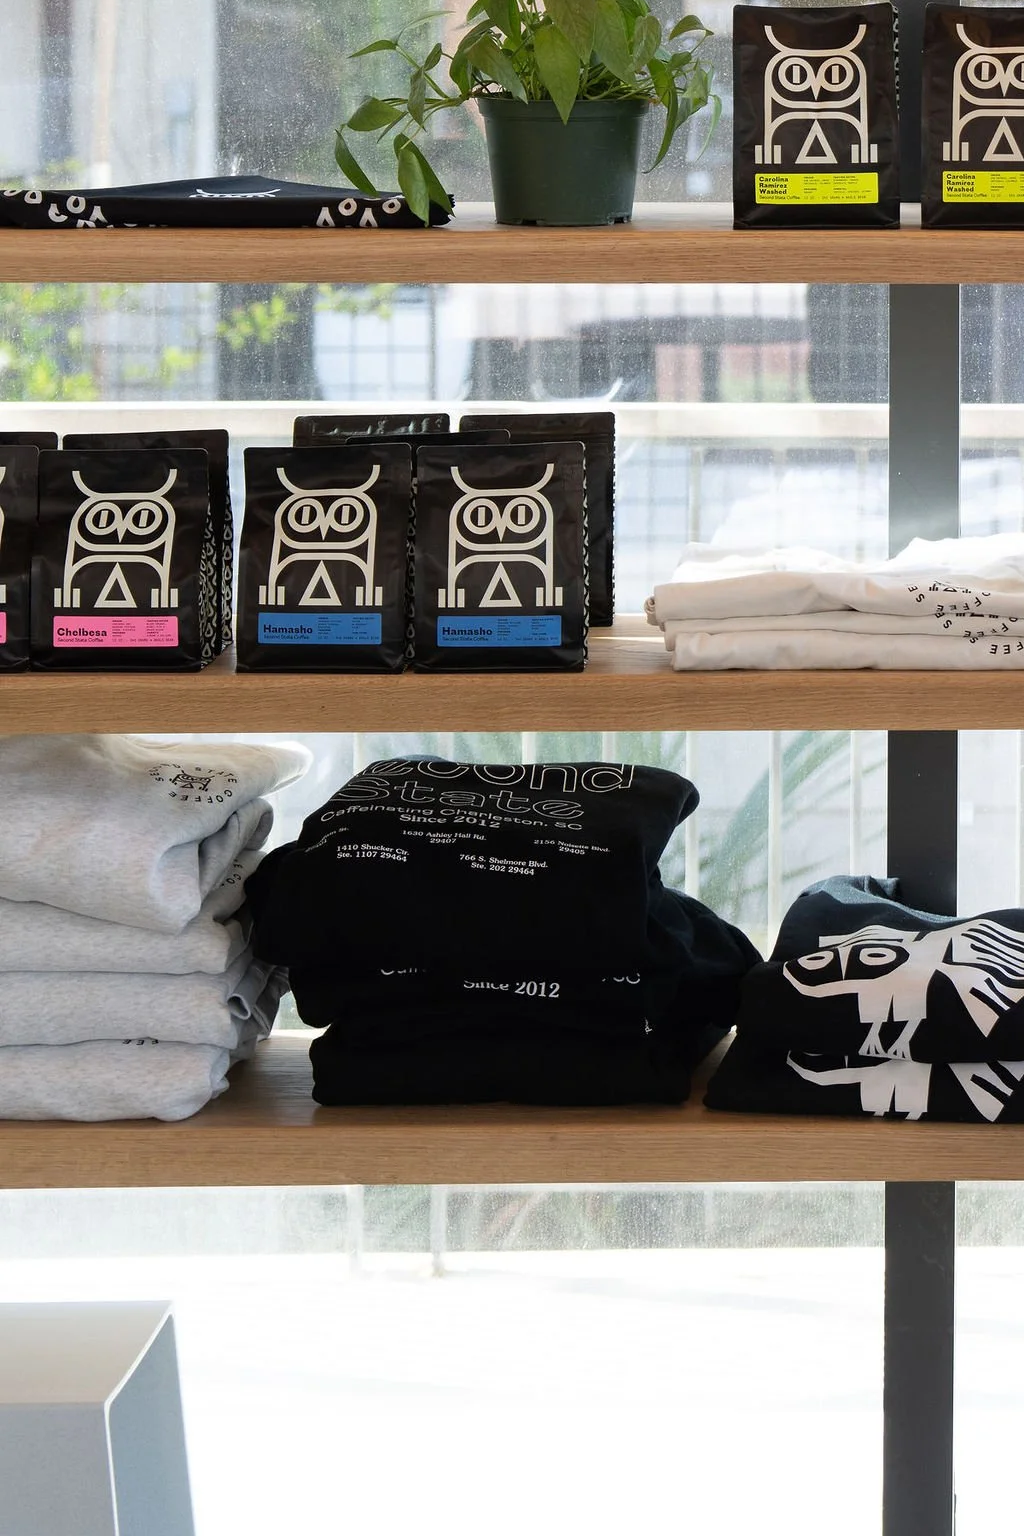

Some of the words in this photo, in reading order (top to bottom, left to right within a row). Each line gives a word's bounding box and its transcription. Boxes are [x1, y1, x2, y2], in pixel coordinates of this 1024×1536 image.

[57, 627, 107, 637] Chelbesa
[263, 624, 313, 634] Hamasho
[442, 626, 493, 636] Hamasho
[358, 761, 635, 793] econd
[168, 789, 233, 804] COFFEE
[329, 776, 584, 820] State
[320, 805, 434, 822] Caffeinating
[554, 821, 583, 830] SC
[400, 814, 447, 824] Since
[453, 816, 500, 828] 2012
[426, 832, 453, 840] Ashley
[337, 844, 358, 852] 1410
[361, 844, 394, 853] Shucker
[396, 848, 410, 856] Cir.
[557, 840, 589, 850] Noisette
[591, 845, 611, 853] Blvd.
[558, 846, 585, 855] 29405
[380, 852, 407, 862] 29464
[489, 856, 526, 866] Shelmore
[528, 860, 548, 868] Blvd.
[471, 861, 486, 870] Ste.
[489, 864, 505, 872] 202
[508, 865, 535, 875] 29464
[514, 980, 560, 998] 2012
